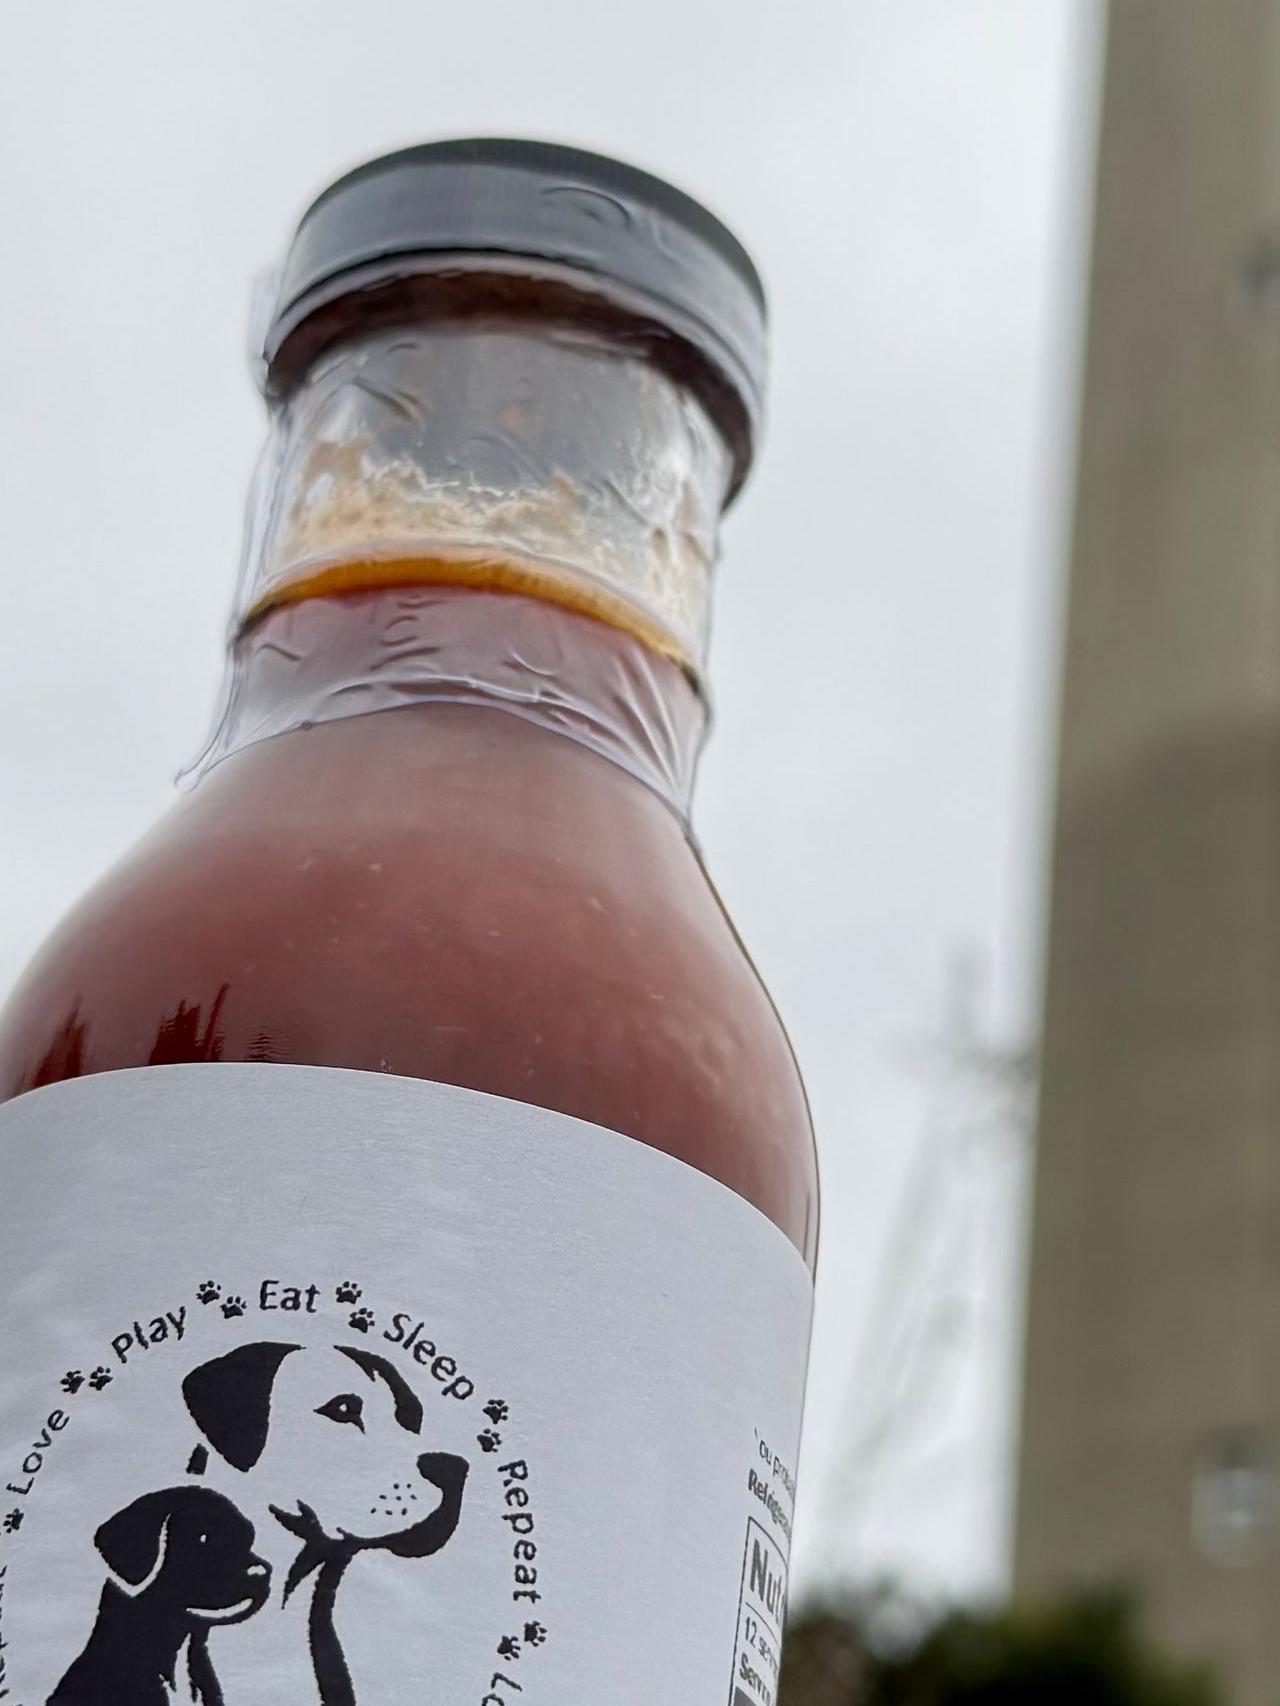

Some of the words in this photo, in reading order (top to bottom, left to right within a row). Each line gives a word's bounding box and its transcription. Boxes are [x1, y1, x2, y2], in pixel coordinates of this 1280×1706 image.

[259, 1279, 321, 1314] Eat
[110, 1305, 187, 1365] Play
[382, 1313, 475, 1401] Sleep
[6, 1409, 71, 1496] Love
[497, 1459, 542, 1605] Repeat
[745, 1615, 757, 1649] 12
